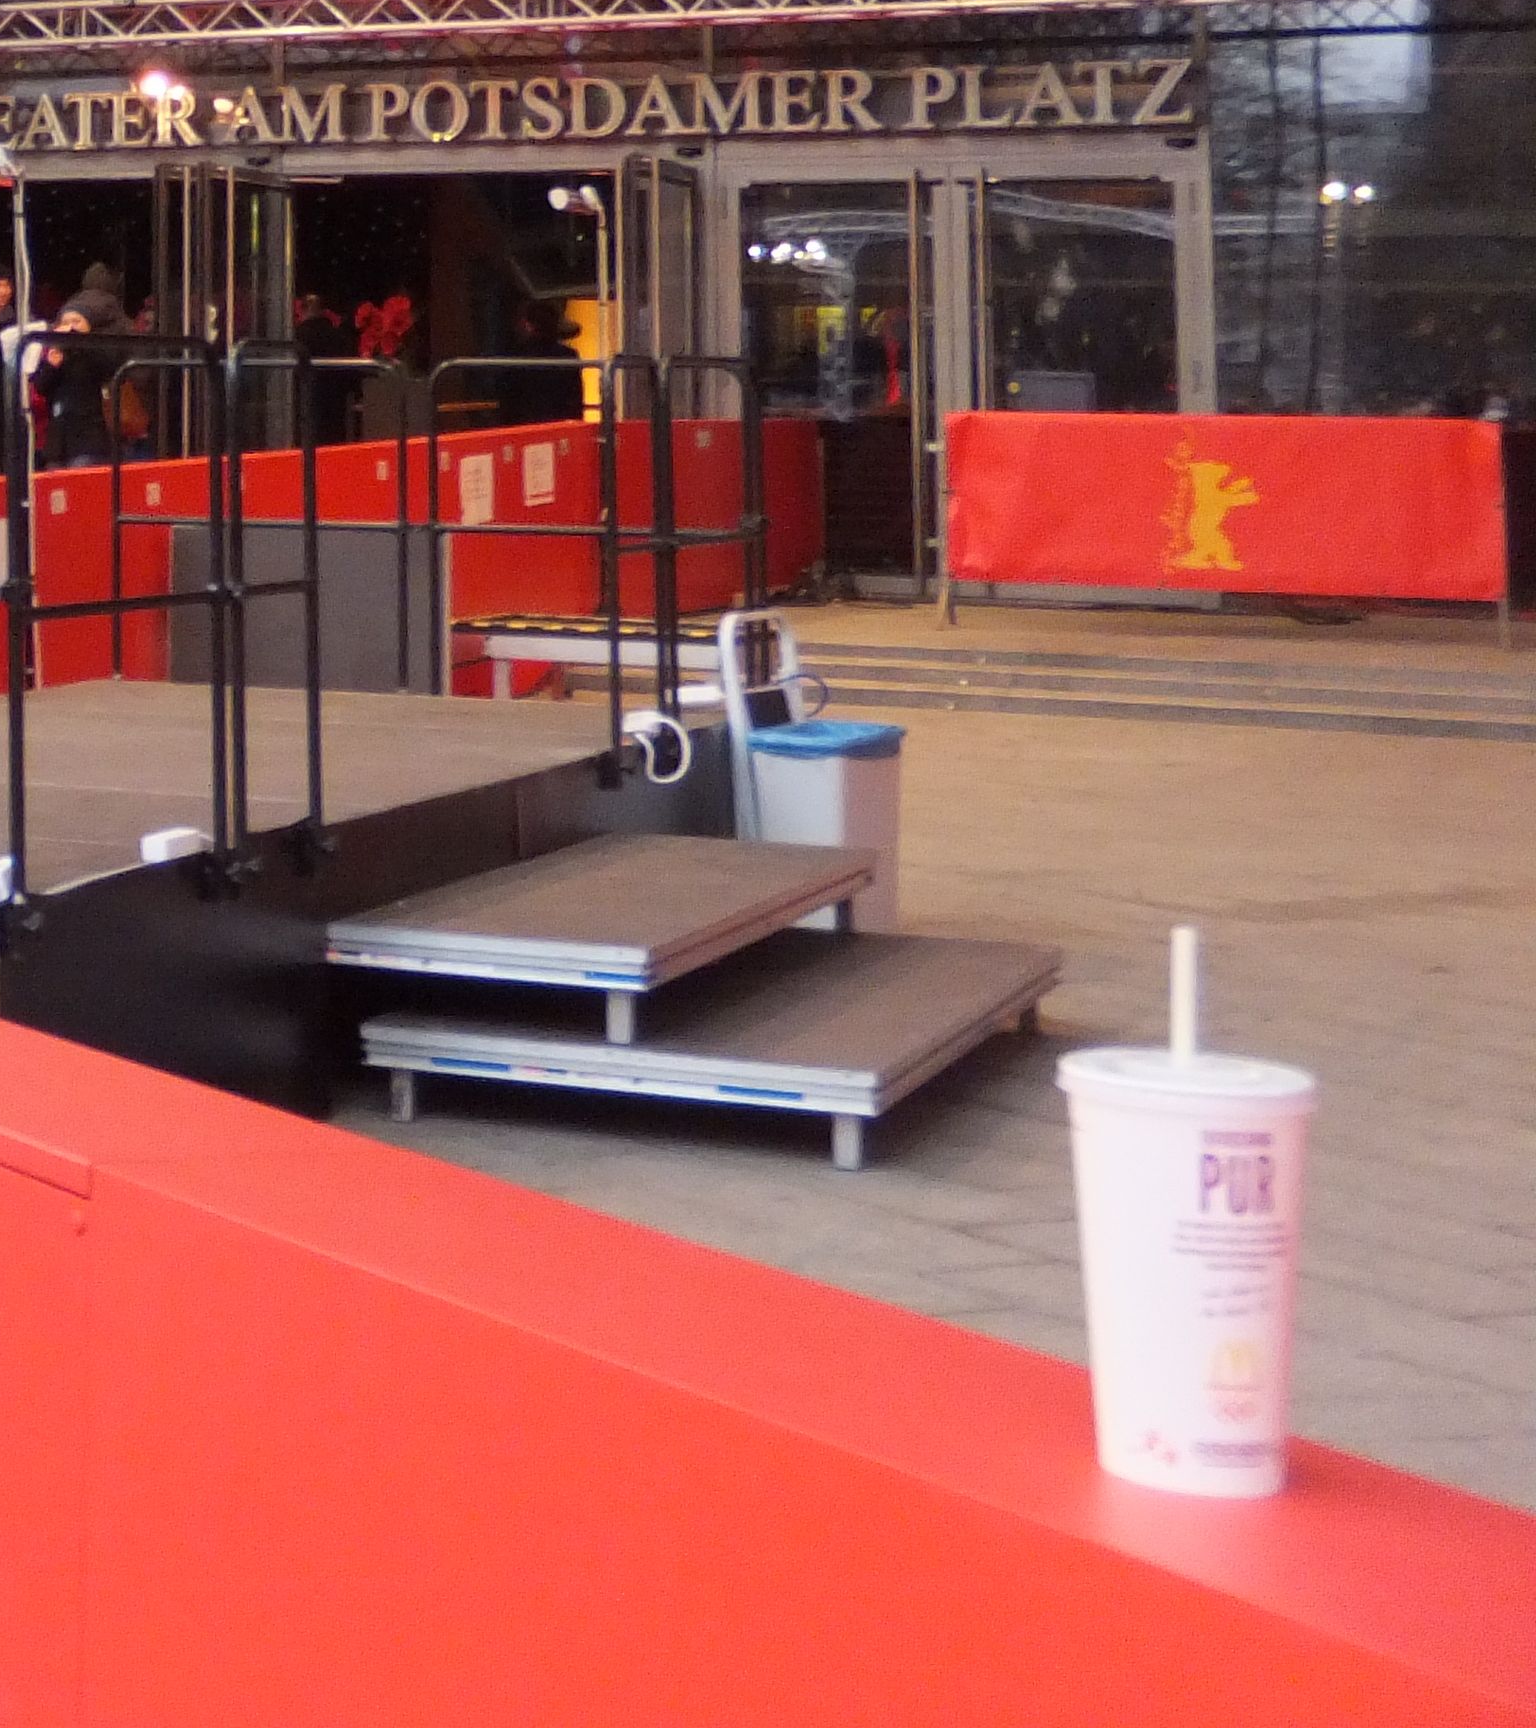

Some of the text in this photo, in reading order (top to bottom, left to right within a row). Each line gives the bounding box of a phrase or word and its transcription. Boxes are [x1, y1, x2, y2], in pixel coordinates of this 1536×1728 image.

[226, 83, 349, 143] AM
[365, 69, 883, 141] POTSDAMER
[910, 58, 1193, 129] PLATZ
